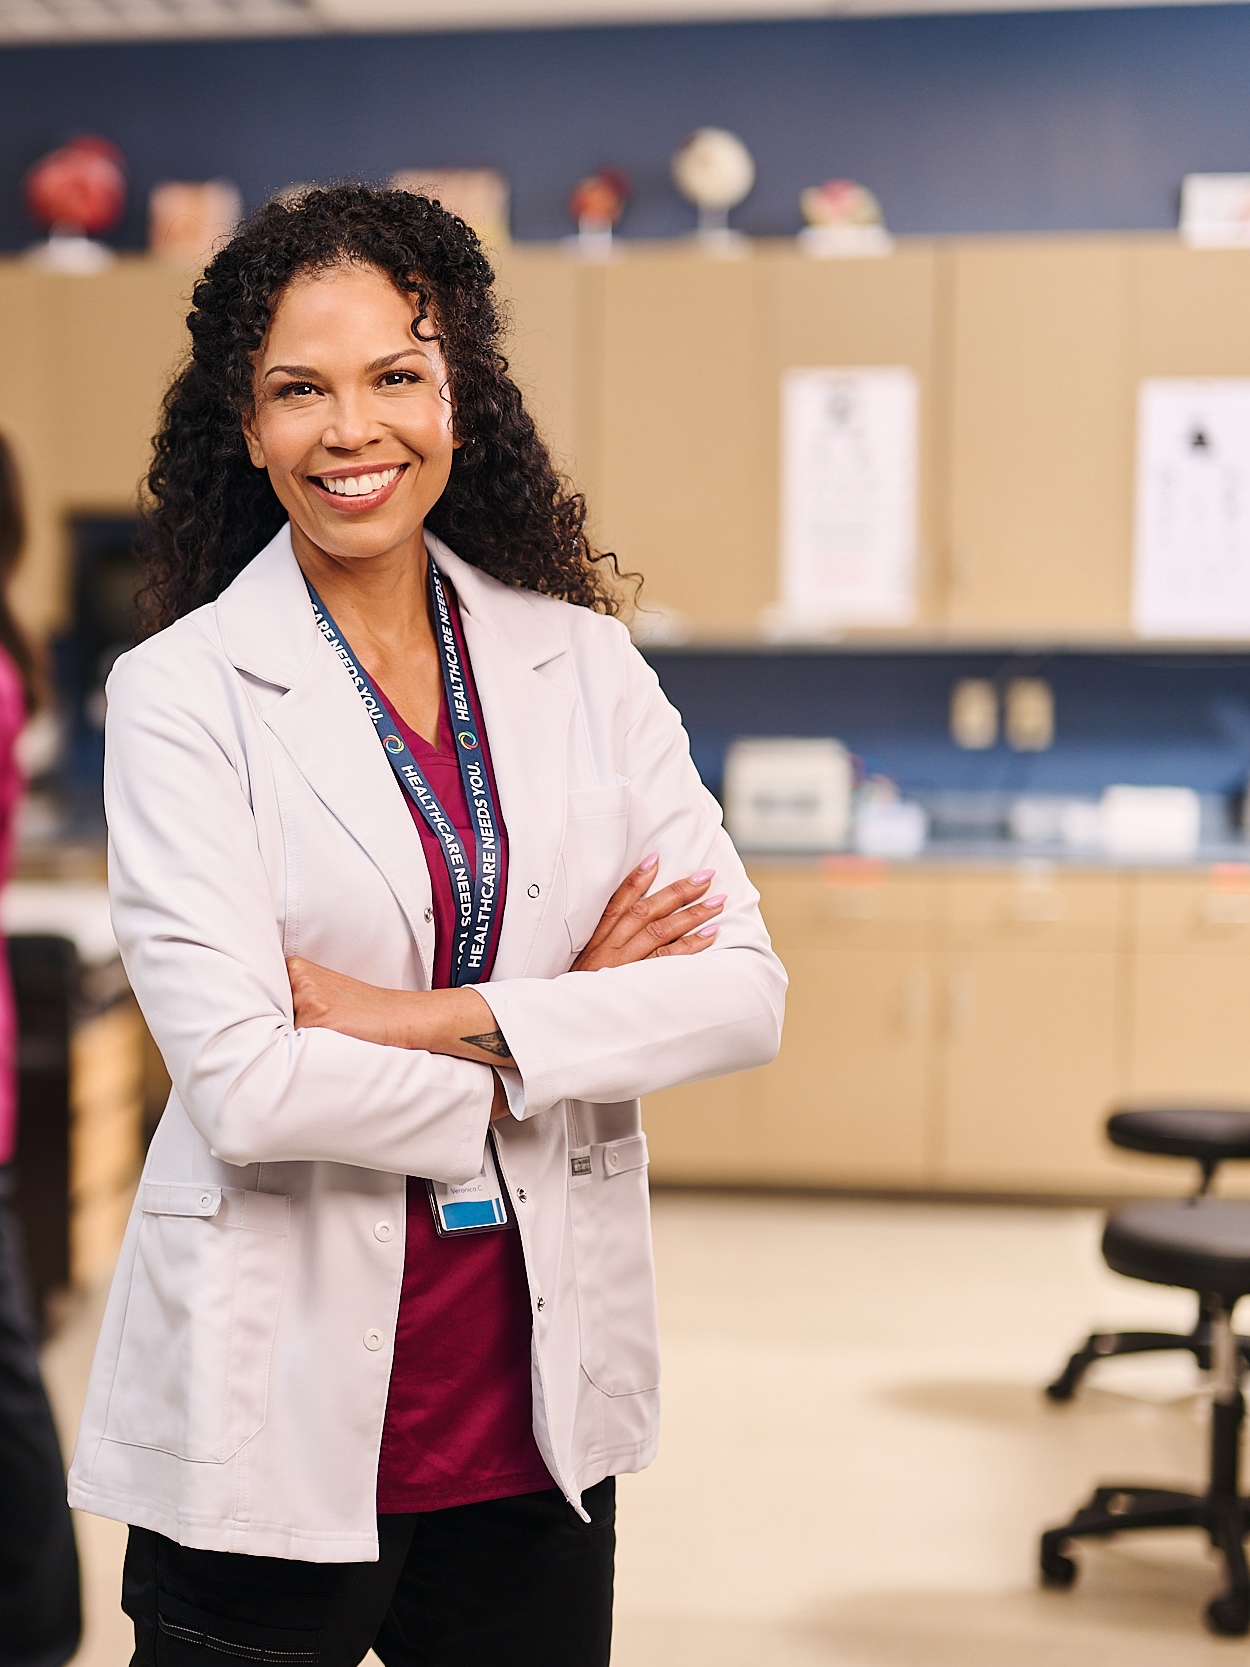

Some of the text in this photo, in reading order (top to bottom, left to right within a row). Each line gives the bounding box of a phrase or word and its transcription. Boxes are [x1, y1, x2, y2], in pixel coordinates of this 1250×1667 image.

[434, 576, 450, 625] NEEDS
[331, 638, 364, 688] NEEDS
[360, 686, 384, 725] YOU.
[442, 624, 470, 722] HEALTHCARE
[401, 764, 464, 866] HEALTHCARE
[454, 867, 472, 927] NEEDS
[466, 761, 496, 968] HEALTHCARE NEEDS YOU.
